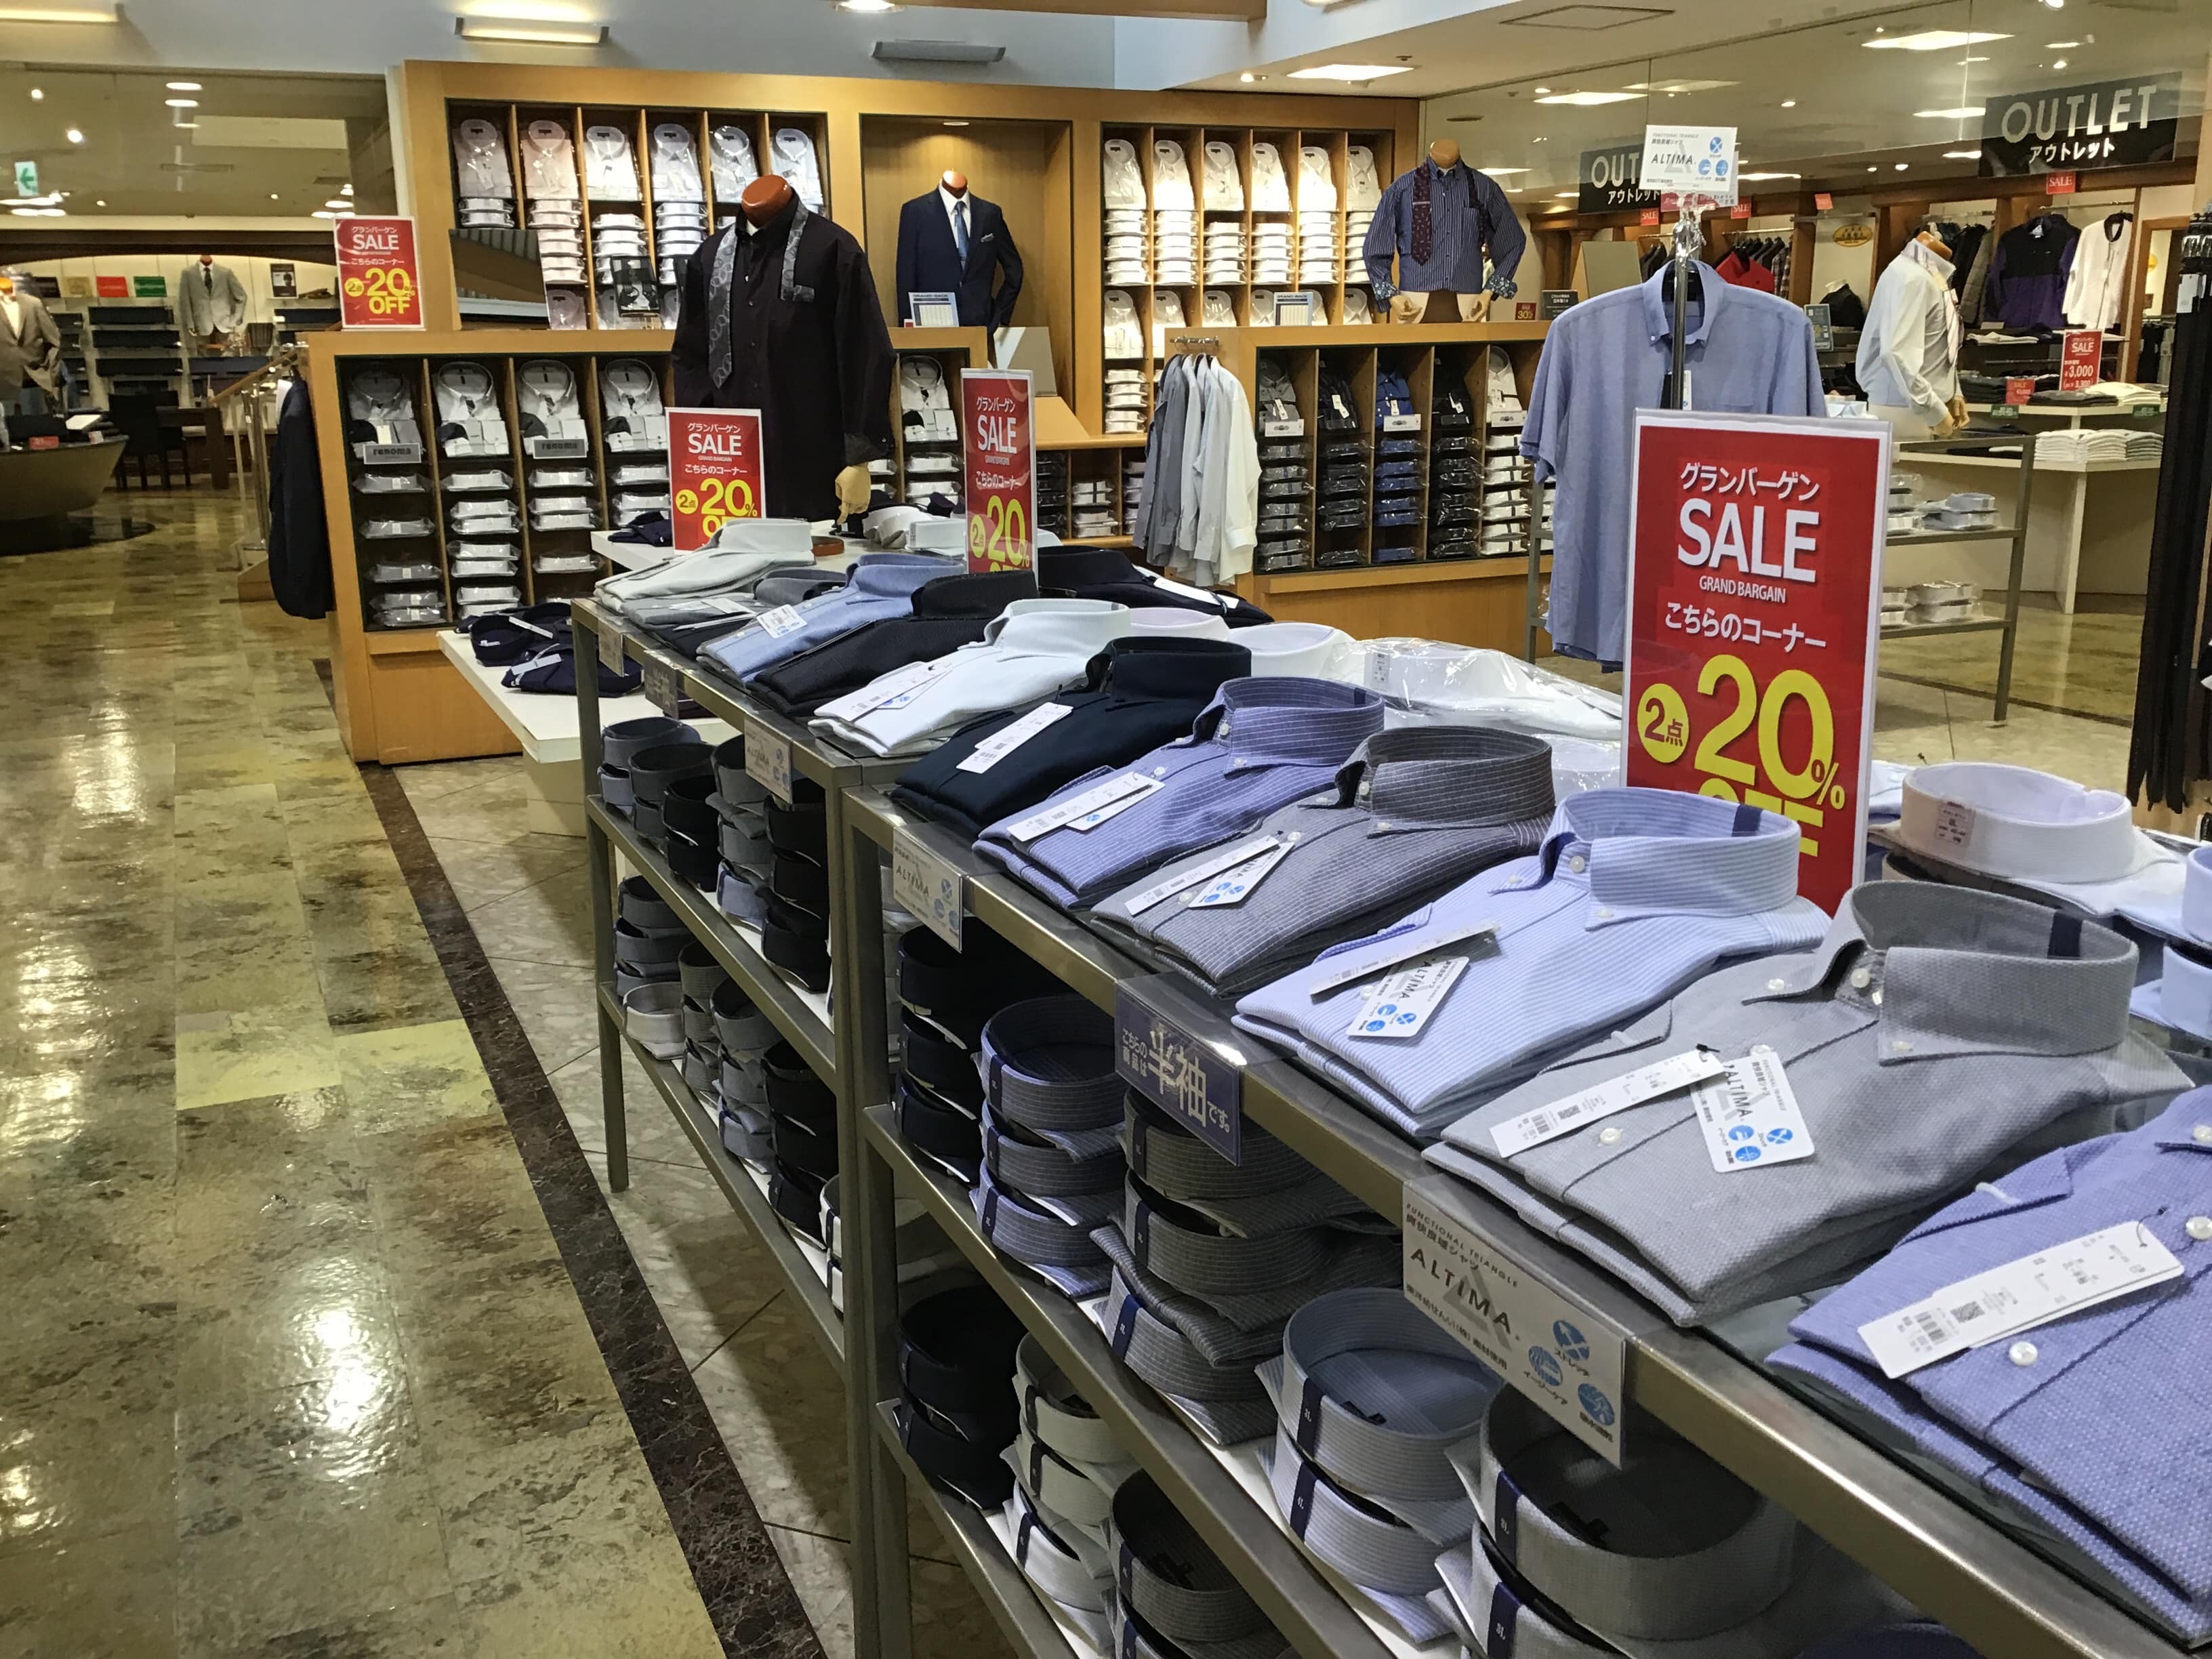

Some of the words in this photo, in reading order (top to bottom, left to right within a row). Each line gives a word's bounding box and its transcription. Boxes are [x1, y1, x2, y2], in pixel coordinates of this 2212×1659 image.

[2001, 84, 2157, 143] OUTLET
[1652, 153, 1693, 164] ALTIMA
[2028, 138, 2115, 163] アウトレット
[1591, 152, 1640, 188] OUT
[2049, 176, 2073, 186] SALE
[1642, 211, 1657, 220] SALE
[352, 234, 399, 250] SALE
[369, 296, 411, 314] OFF
[2071, 342, 2094, 352] SALE
[976, 396, 1016, 413] グランバーゲン
[687, 422, 741, 434] グランバーゲン
[977, 415, 1017, 454] SALE
[373, 447, 411, 455] renoma
[688, 433, 742, 455] SALE
[685, 464, 747, 476] こちらのコーナー
[976, 471, 1021, 491] こちらのコーナー
[1680, 462, 1820, 501] グランバーゲン
[700, 478, 758, 517] 20%
[1677, 497, 1820, 583] SALE
[1699, 575, 1736, 595] GRAND
[1737, 581, 1786, 603] BARGAIN
[1665, 602, 1826, 653] こちらのコーナー
[1643, 697, 1685, 747] 2点
[1694, 653, 1846, 811] 20%
[895, 865, 930, 898] ALTIMA
[1399, 960, 1432, 999] ALTIMA
[1122, 1028, 1147, 1059] こちらの
[1724, 1071, 1754, 1118] ALTIMA
[1406, 1203, 1466, 1250] FUNCTIONAL
[1469, 1248, 1519, 1288] TRIANGLE
[1410, 1248, 1511, 1335] ALTIMA
